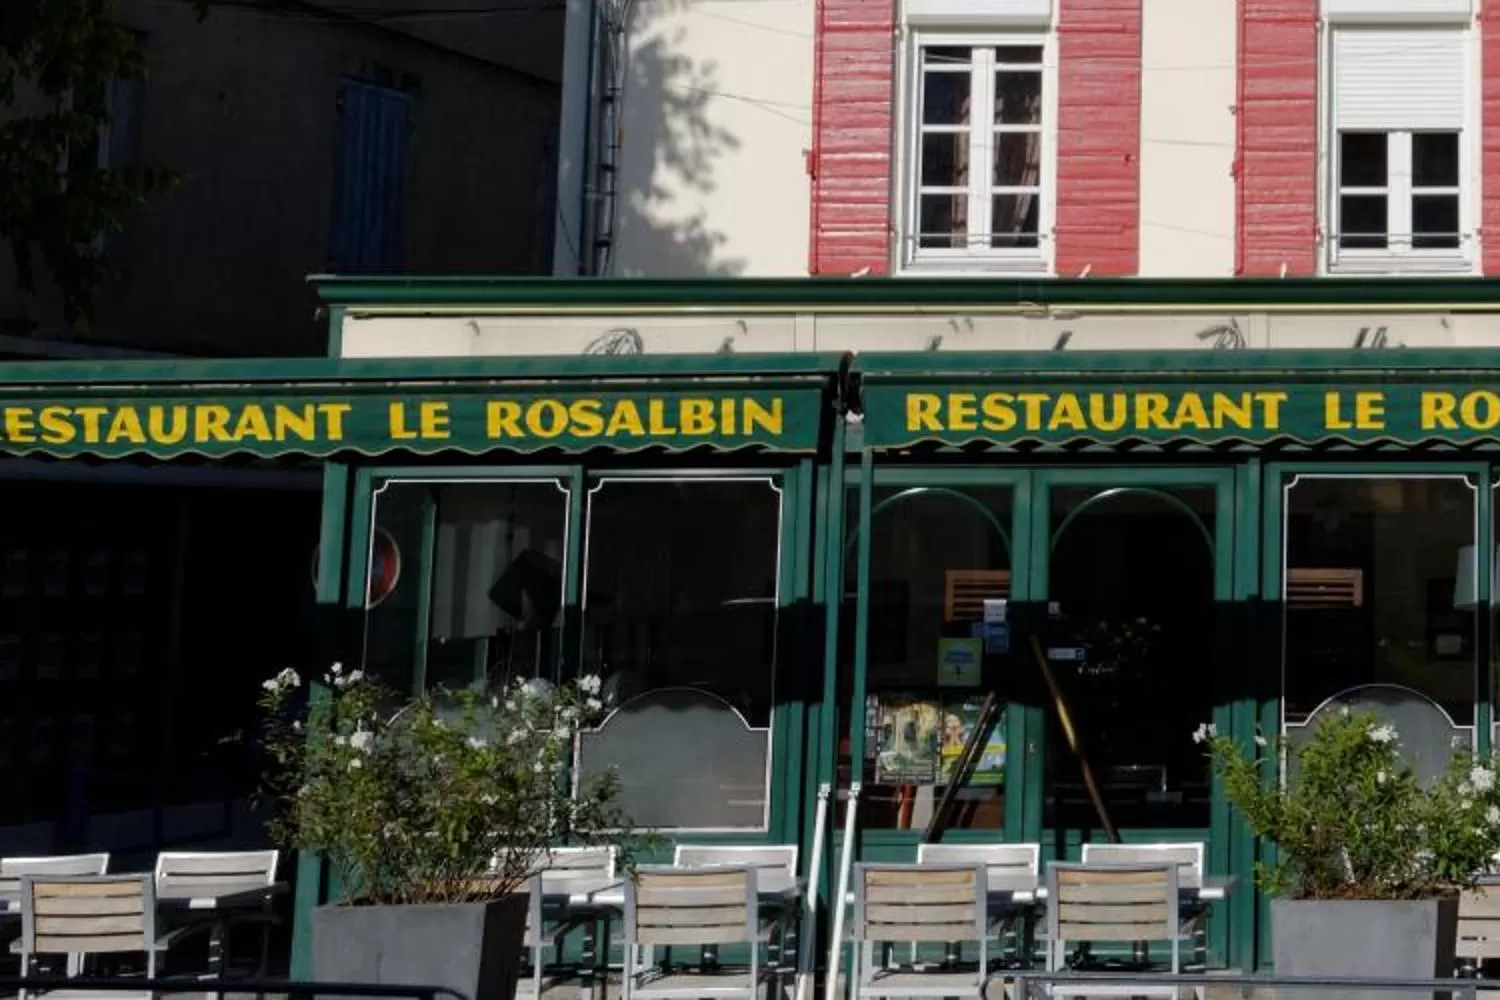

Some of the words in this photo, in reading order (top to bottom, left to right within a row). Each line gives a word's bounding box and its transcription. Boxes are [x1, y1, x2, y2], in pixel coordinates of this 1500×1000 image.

[0, 403, 351, 444] ESTAURANT
[391, 401, 450, 438] LE
[487, 398, 783, 437] ROSALBIN
[907, 391, 1287, 432] RESTAURANT
[1325, 392, 1385, 430] LE
